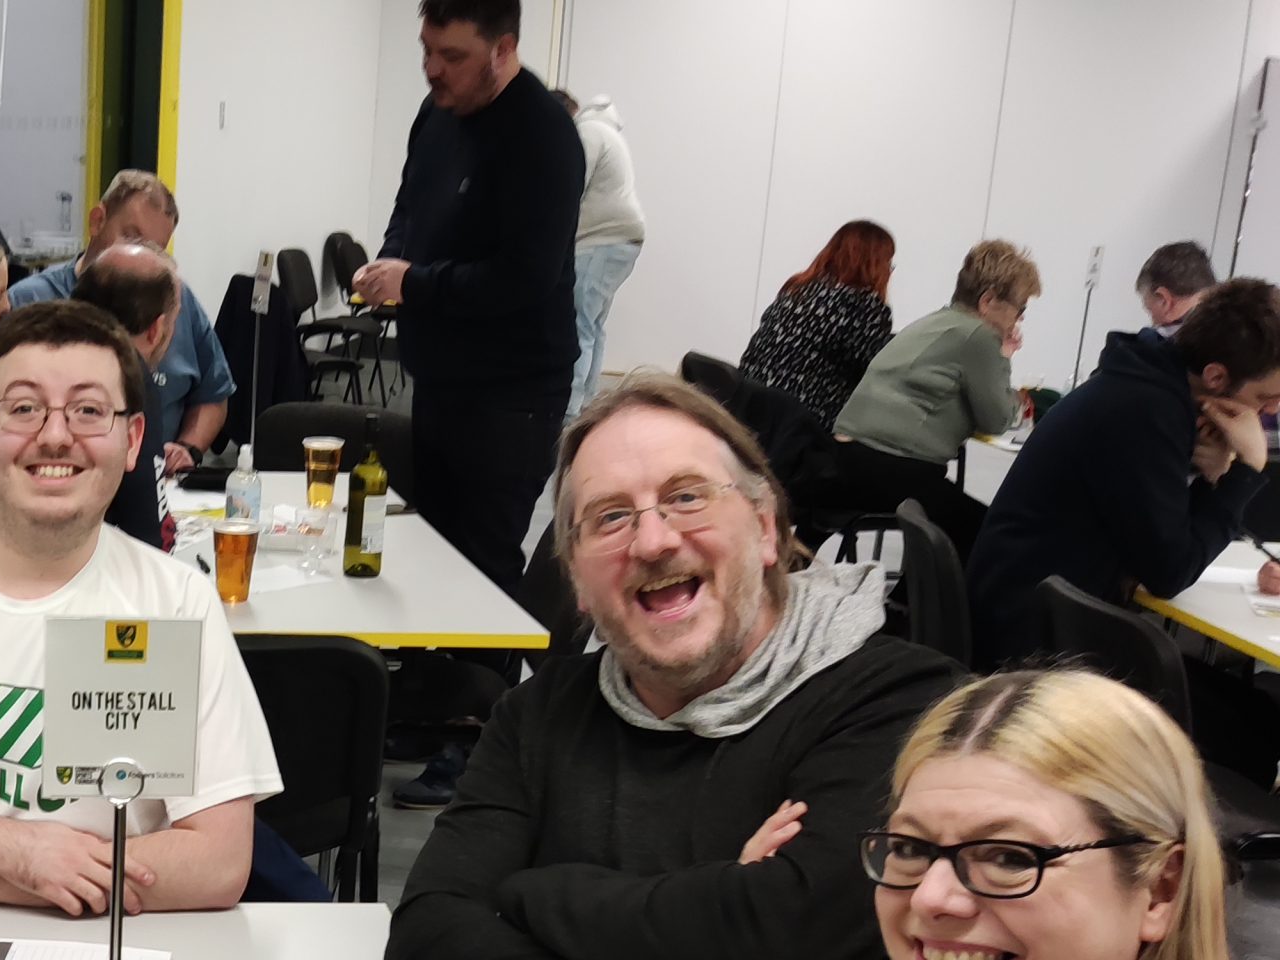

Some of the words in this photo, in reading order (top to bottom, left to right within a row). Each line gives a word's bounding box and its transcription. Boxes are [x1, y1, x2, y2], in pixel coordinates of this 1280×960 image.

[72, 691, 92, 710] ON
[95, 691, 125, 710] THE
[127, 691, 176, 711] STALL
[105, 711, 141, 730] CITY
